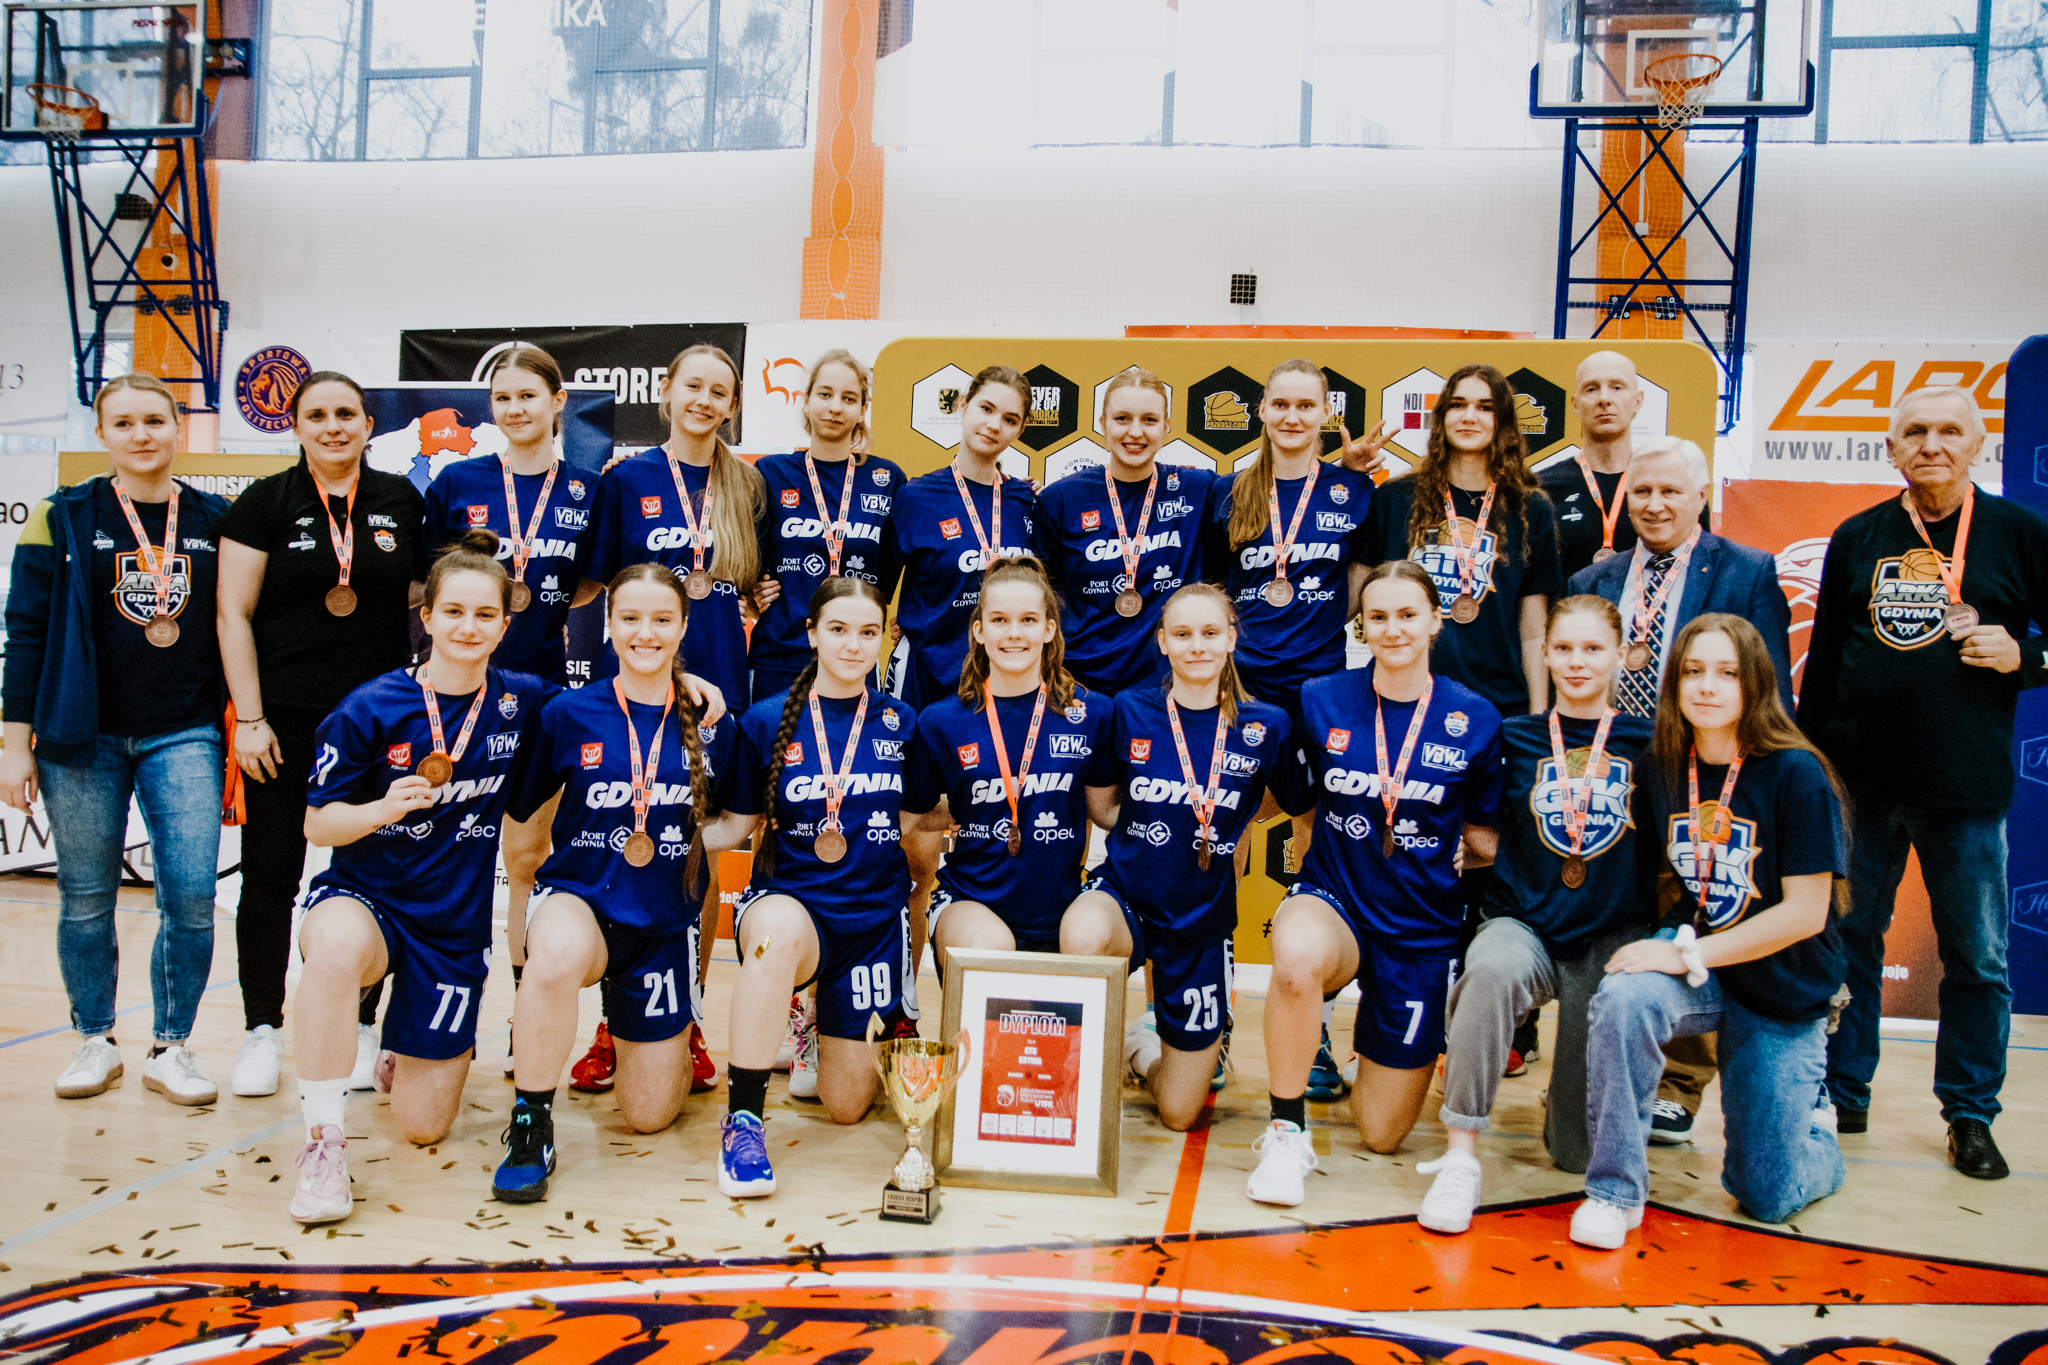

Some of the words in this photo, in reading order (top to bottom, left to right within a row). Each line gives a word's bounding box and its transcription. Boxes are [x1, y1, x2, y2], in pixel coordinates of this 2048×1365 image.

[241, 349, 307, 375] SPORTOWA
[1031, 387, 1060, 400] EVER
[1404, 393, 1422, 410] NDI
[1032, 410, 1059, 419] MORZE
[862, 495, 888, 511] VBW
[1158, 498, 1183, 519] VBW
[296, 517, 314, 527] 4F
[369, 515, 390, 526] VBW
[556, 509, 585, 526] VBW
[1318, 513, 1347, 528] VBW
[184, 539, 209, 550] VBW
[493, 537, 577, 561] DNIA
[1085, 531, 1181, 562] GDYNIA
[1240, 542, 1340, 571] GDNIA
[777, 564, 801, 573] GDYNIA
[116, 573, 188, 591] ARA
[712, 581, 738, 597] ope
[1090, 580, 1109, 588] PORT
[1153, 578, 1183, 593] ope
[1428, 574, 1478, 590] DYNA
[126, 593, 180, 603] GDYA
[1871, 582, 1951, 606] ARKA
[1880, 607, 1942, 619] GDYNIA
[566, 660, 591, 679] SIĘ
[489, 733, 519, 756] VBW
[1051, 736, 1083, 754] VBW
[1426, 745, 1458, 766] VBW
[586, 781, 693, 809] GDNI
[785, 773, 902, 802] GDYNIA
[1130, 776, 1241, 810] GDYNIA
[1534, 778, 1629, 820] GTK
[969, 823, 989, 832] PORT
[1549, 814, 1614, 826] GNIA
[456, 824, 495, 841] ec
[582, 831, 605, 840] PORT
[959, 830, 990, 839] GDYNIA
[571, 837, 605, 848] GDYNIA
[659, 843, 692, 860] ope
[1685, 879, 1738, 898] GDNIA
[644, 968, 679, 1017] 21
[851, 962, 891, 1010] 99
[429, 983, 471, 1033] 77
[1184, 984, 1219, 1032] 25
[999, 1013, 1066, 1036] DYPLOM
[1403, 1000, 1424, 1045] 7
